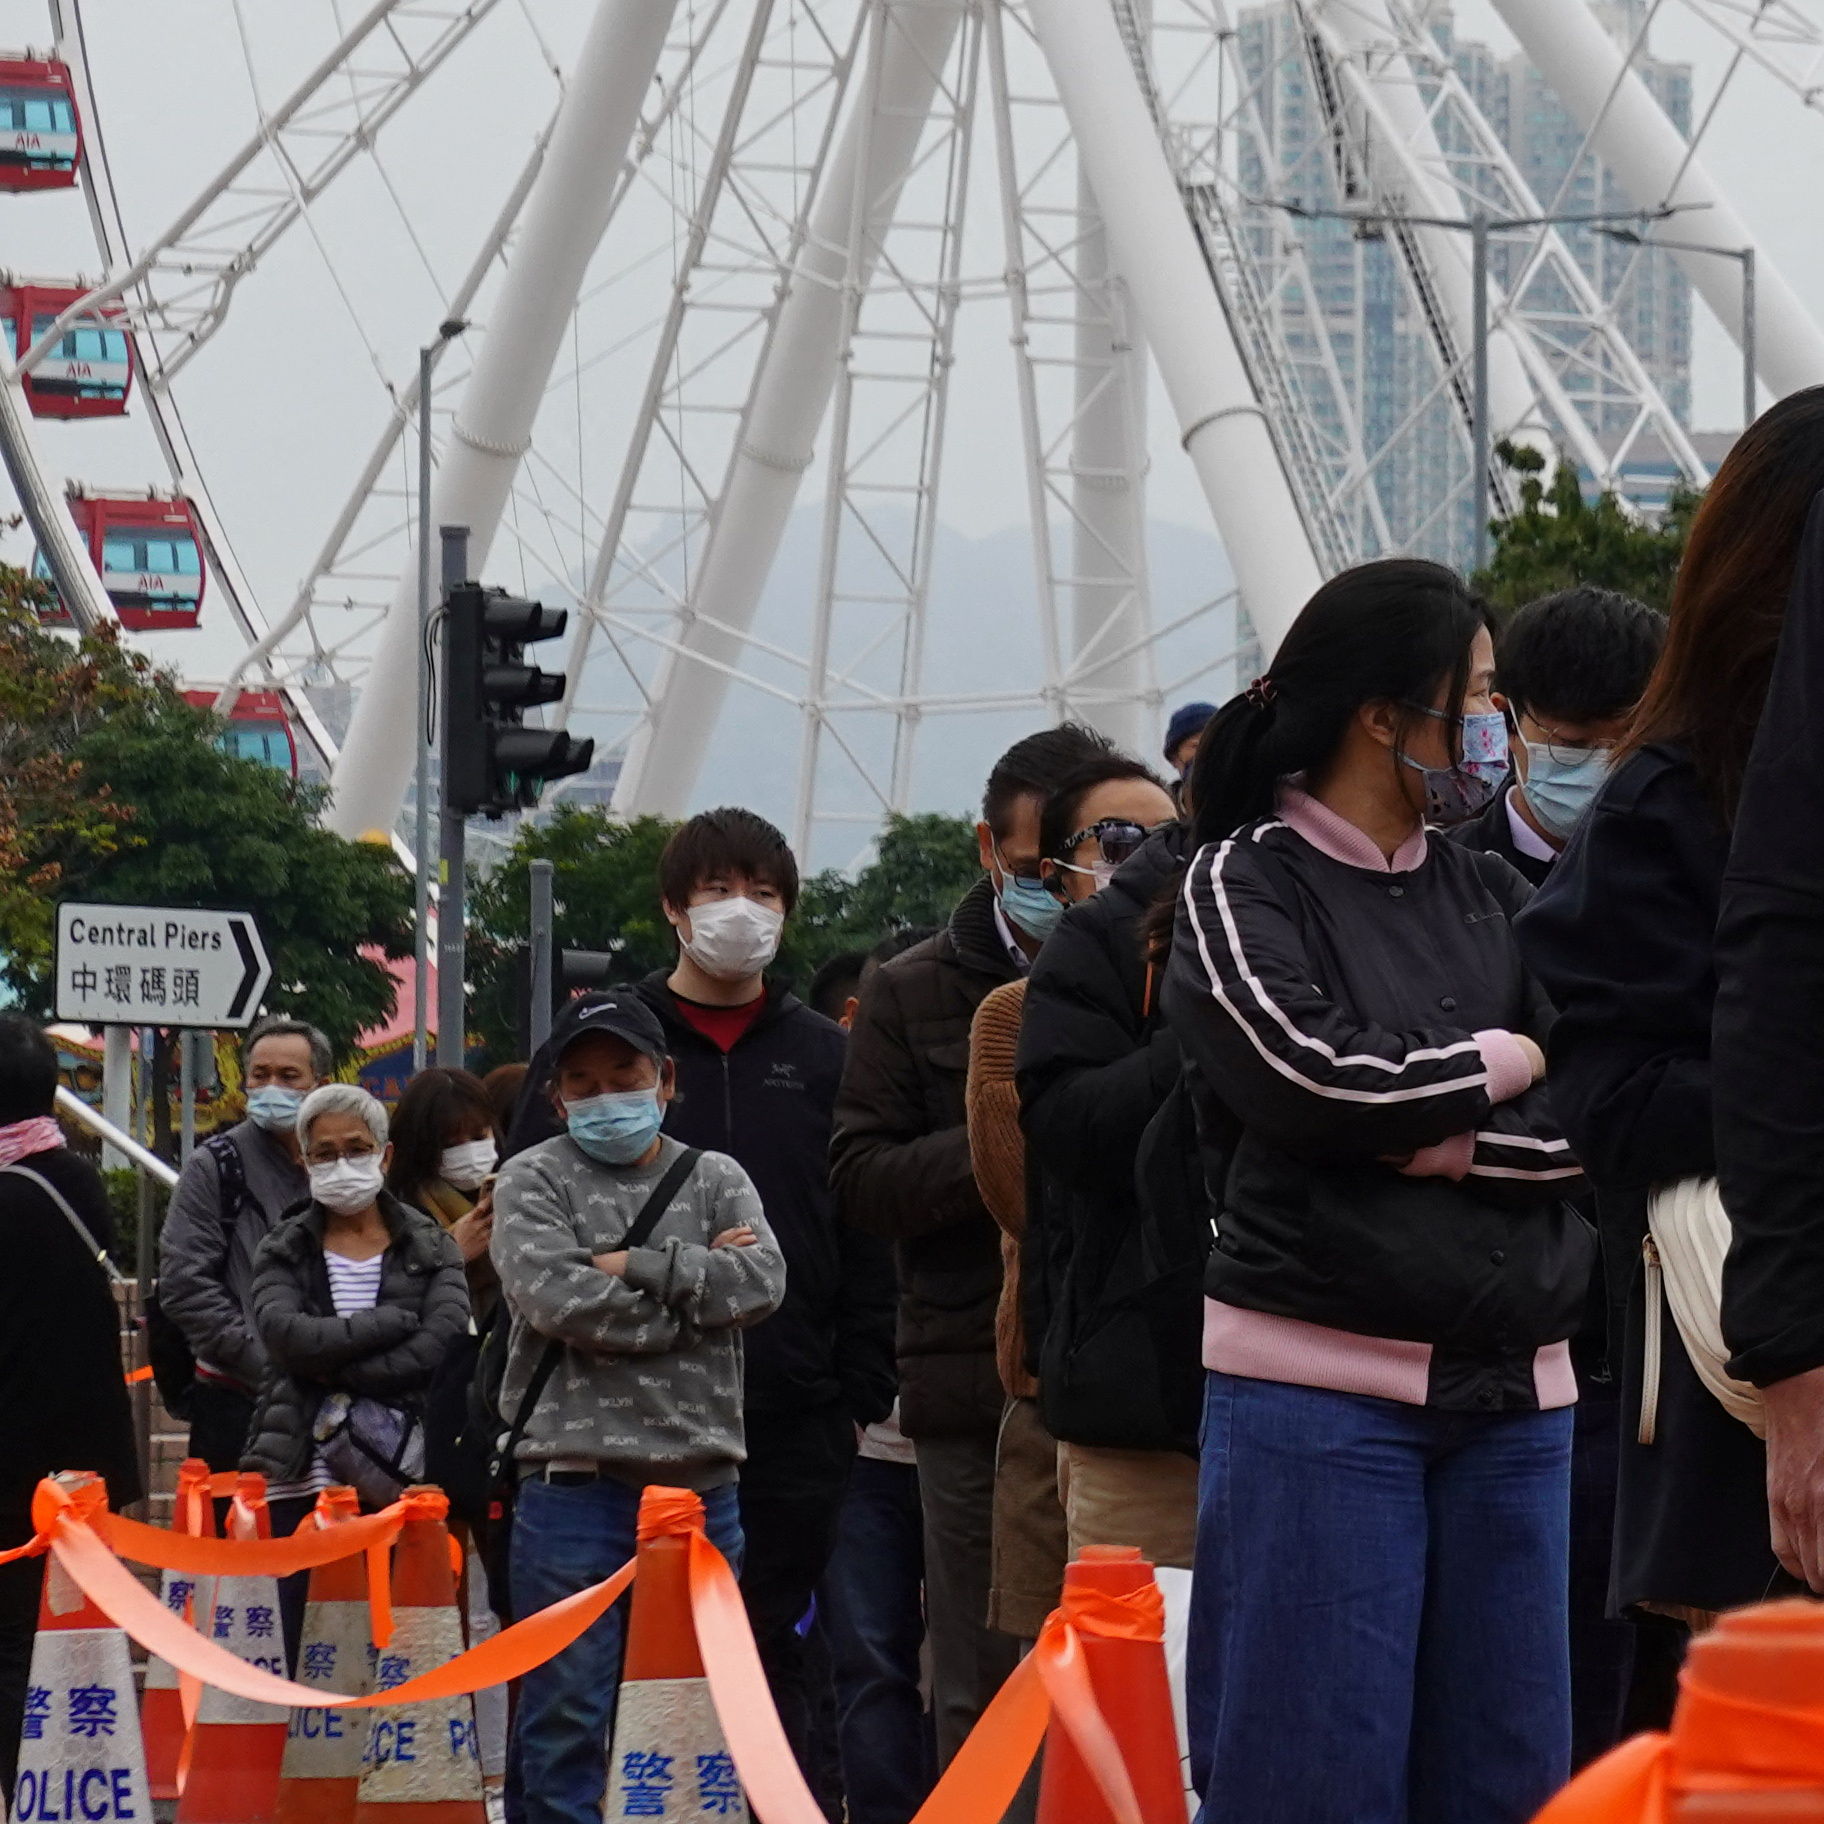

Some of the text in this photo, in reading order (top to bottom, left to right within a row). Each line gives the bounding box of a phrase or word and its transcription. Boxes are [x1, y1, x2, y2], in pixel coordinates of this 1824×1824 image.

[16, 133, 41, 150] AIA
[66, 361, 92, 379] AIA
[138, 573, 164, 592] AIA
[70, 918, 222, 951] Central Piers
[71, 962, 201, 1008] 中環碼頭
[16, 1768, 135, 1822] OLICE
[620, 1750, 742, 1816] 警察
